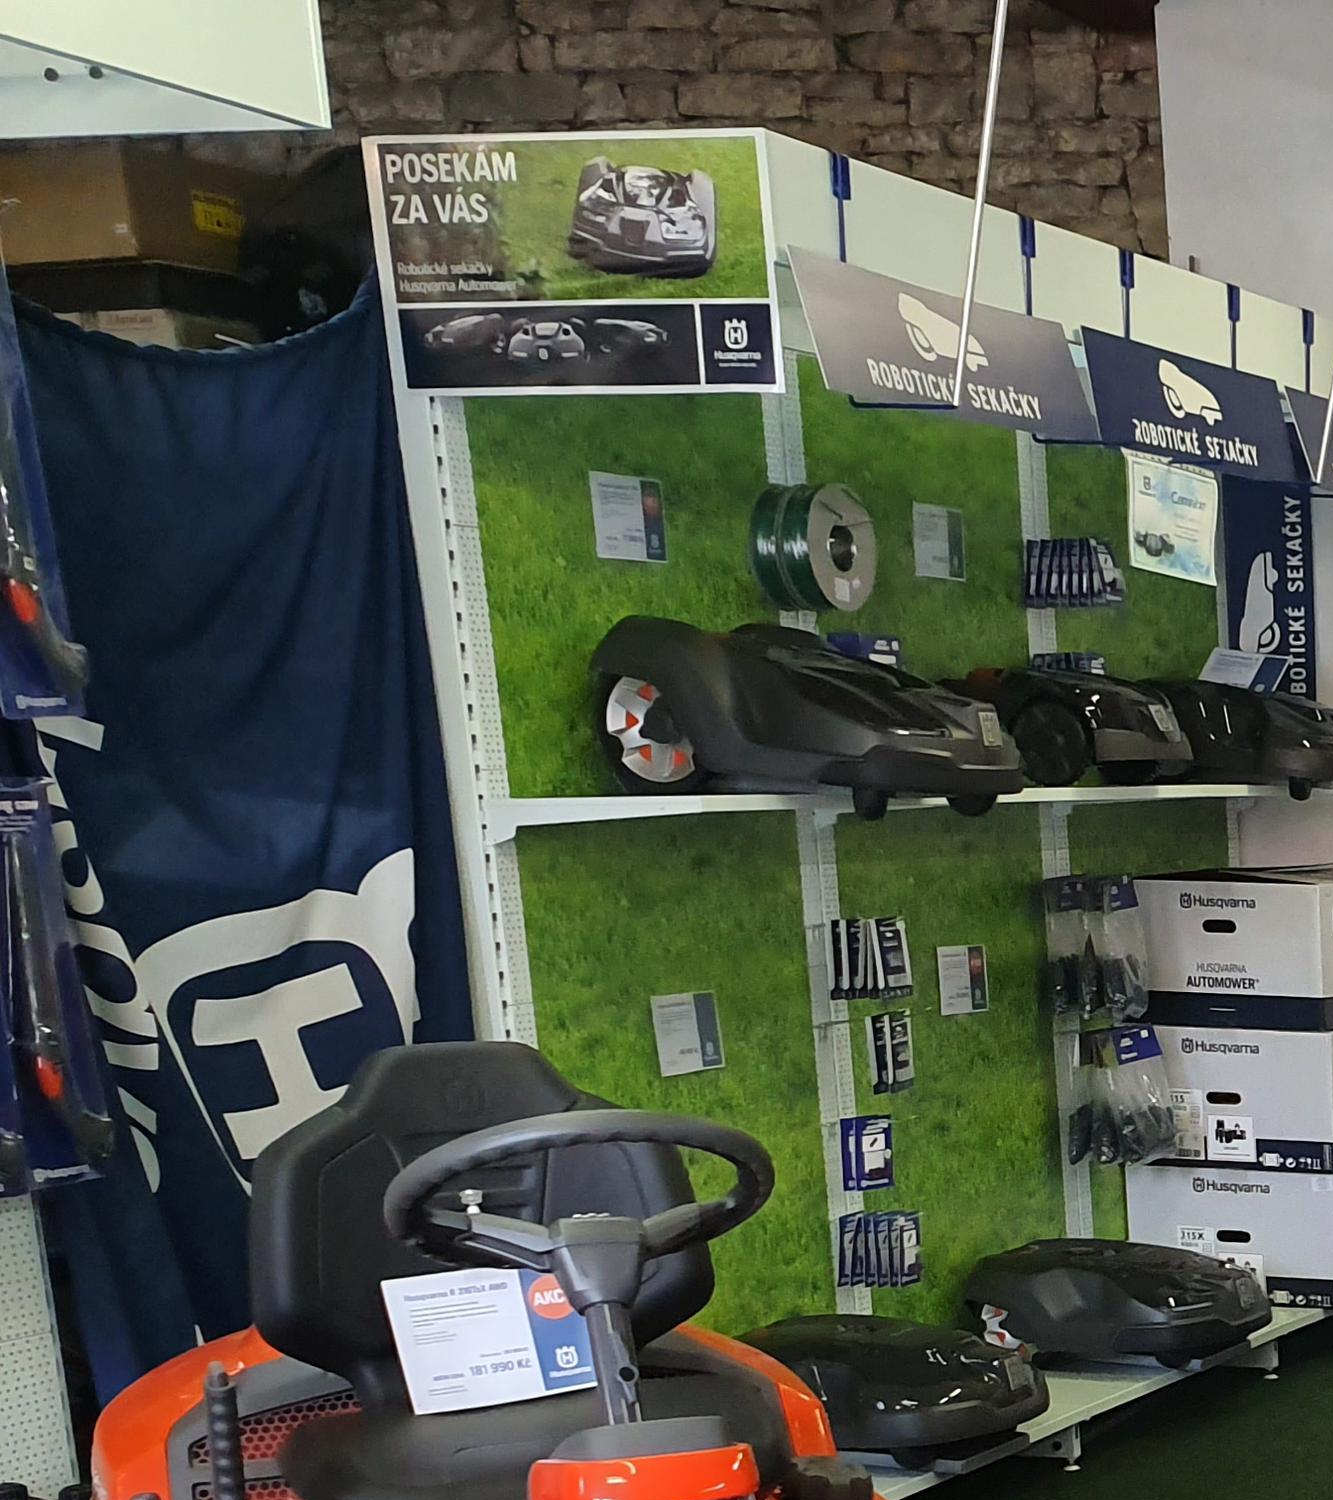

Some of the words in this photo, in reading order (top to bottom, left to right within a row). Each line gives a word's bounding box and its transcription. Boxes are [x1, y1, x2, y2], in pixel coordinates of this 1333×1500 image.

[385, 146, 517, 184] POSEKÁM
[390, 195, 429, 225] ZA
[432, 187, 489, 224] VÁS
[966, 382, 1042, 421] SEKAČKY
[1281, 496, 1305, 593] SEKAČKY
[1193, 895, 1256, 909] Husqvarna
[1196, 962, 1248, 973] HUSQVARNA
[1195, 1040, 1260, 1055] Husqvarna
[1206, 1179, 1271, 1194] Husqvarna
[469, 1361, 488, 1376] 181
[491, 1360, 515, 1374] 990
